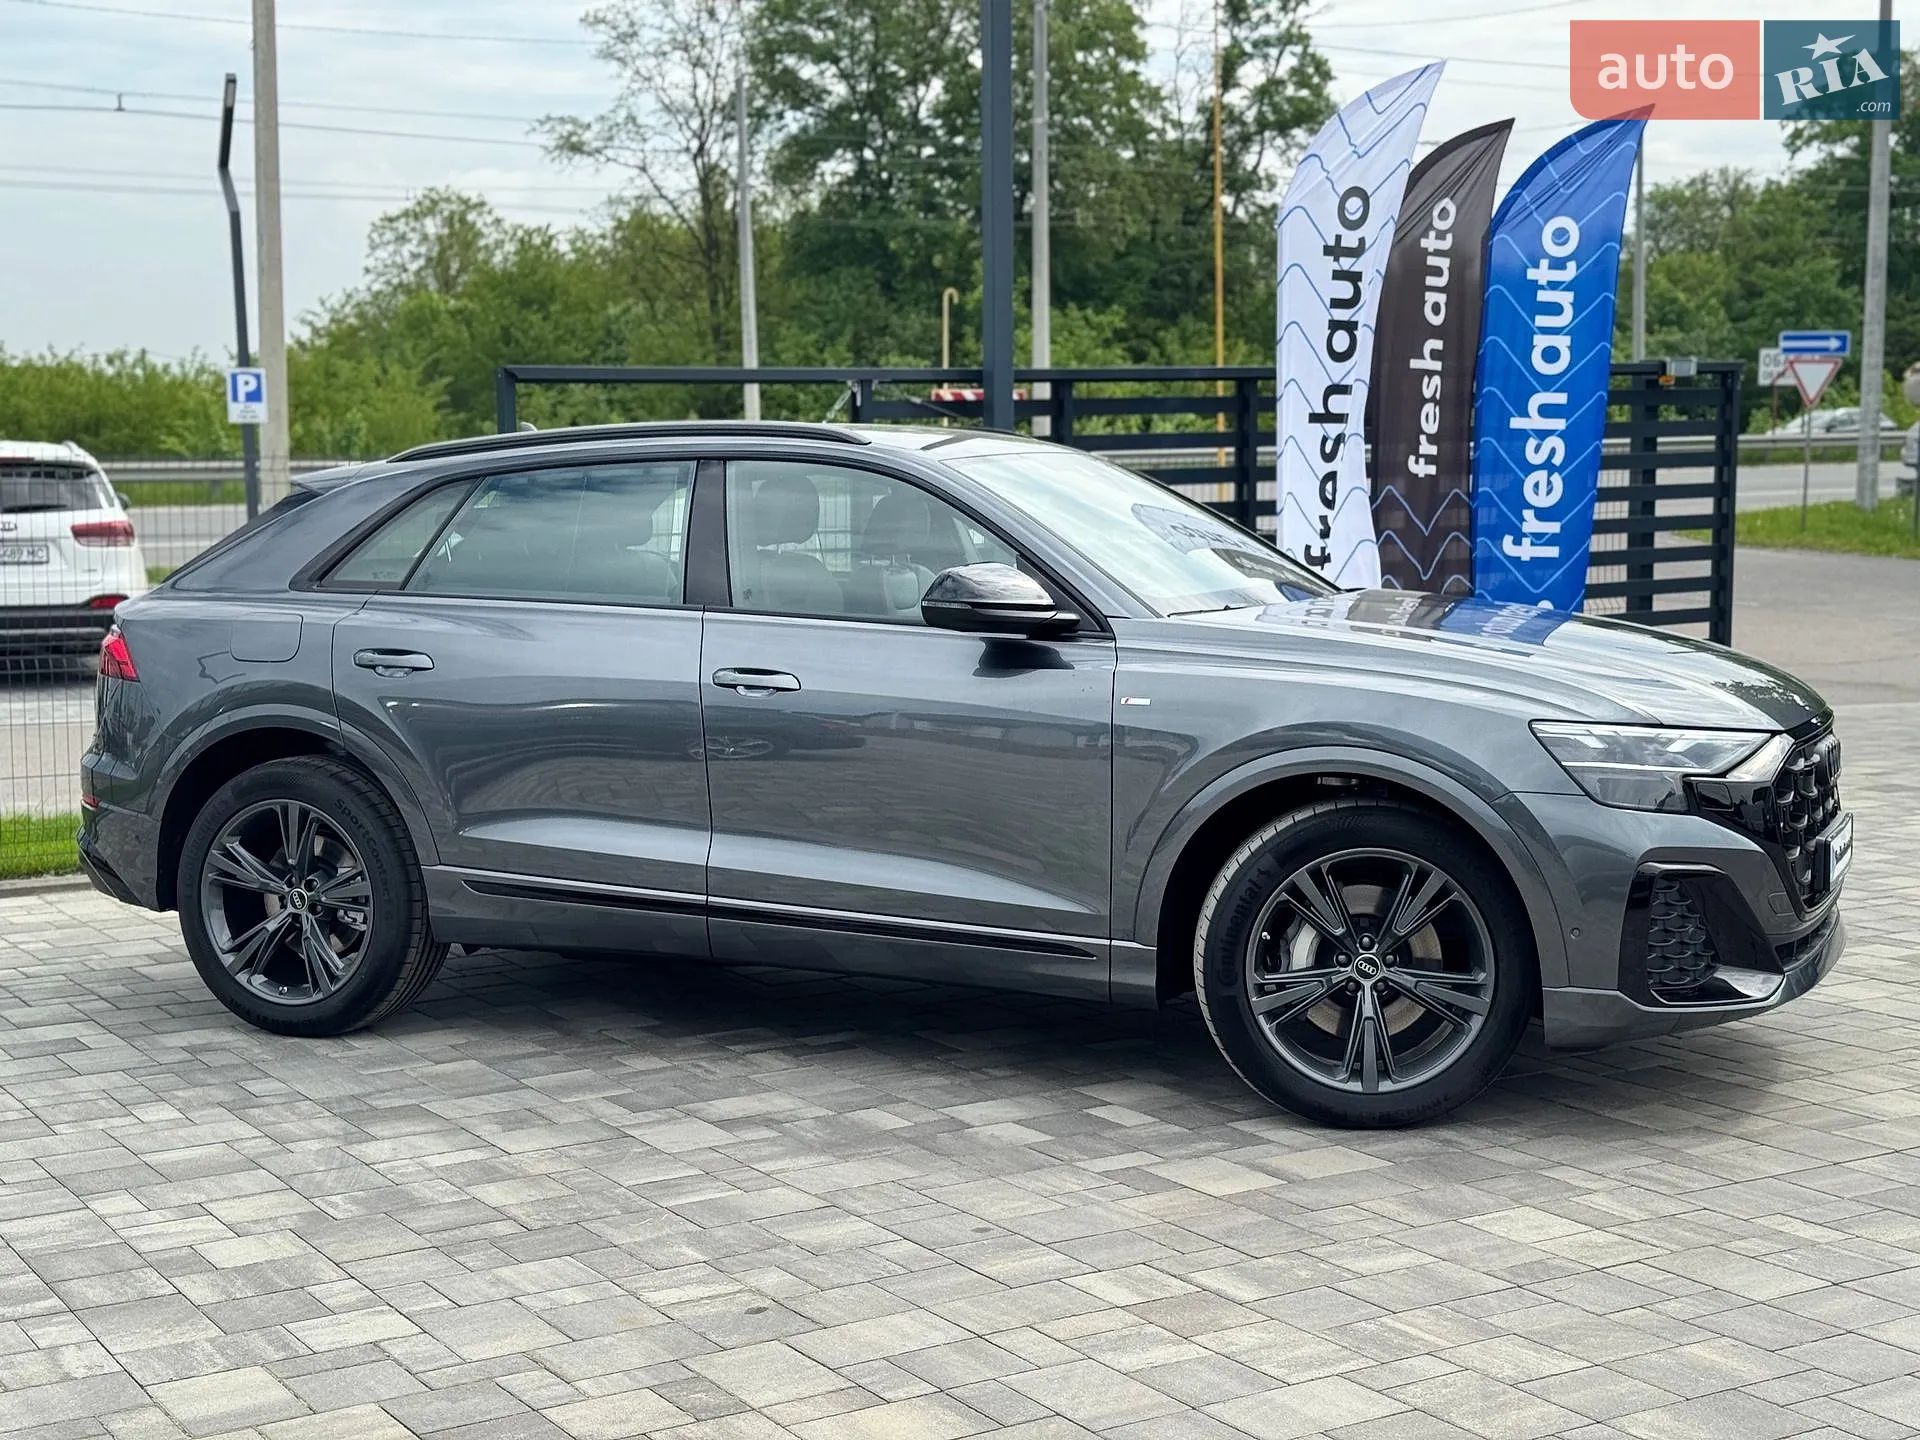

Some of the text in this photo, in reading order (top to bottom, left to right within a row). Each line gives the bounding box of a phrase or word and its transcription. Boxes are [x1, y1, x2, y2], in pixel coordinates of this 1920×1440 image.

[1322, 186, 1370, 363] auto
[1408, 197, 1457, 478] fresh auto
[1527, 216, 1580, 375] auto
[237, 373, 257, 402] P
[1304, 384, 1353, 571] fresh
[1503, 392, 1568, 562] fresh
